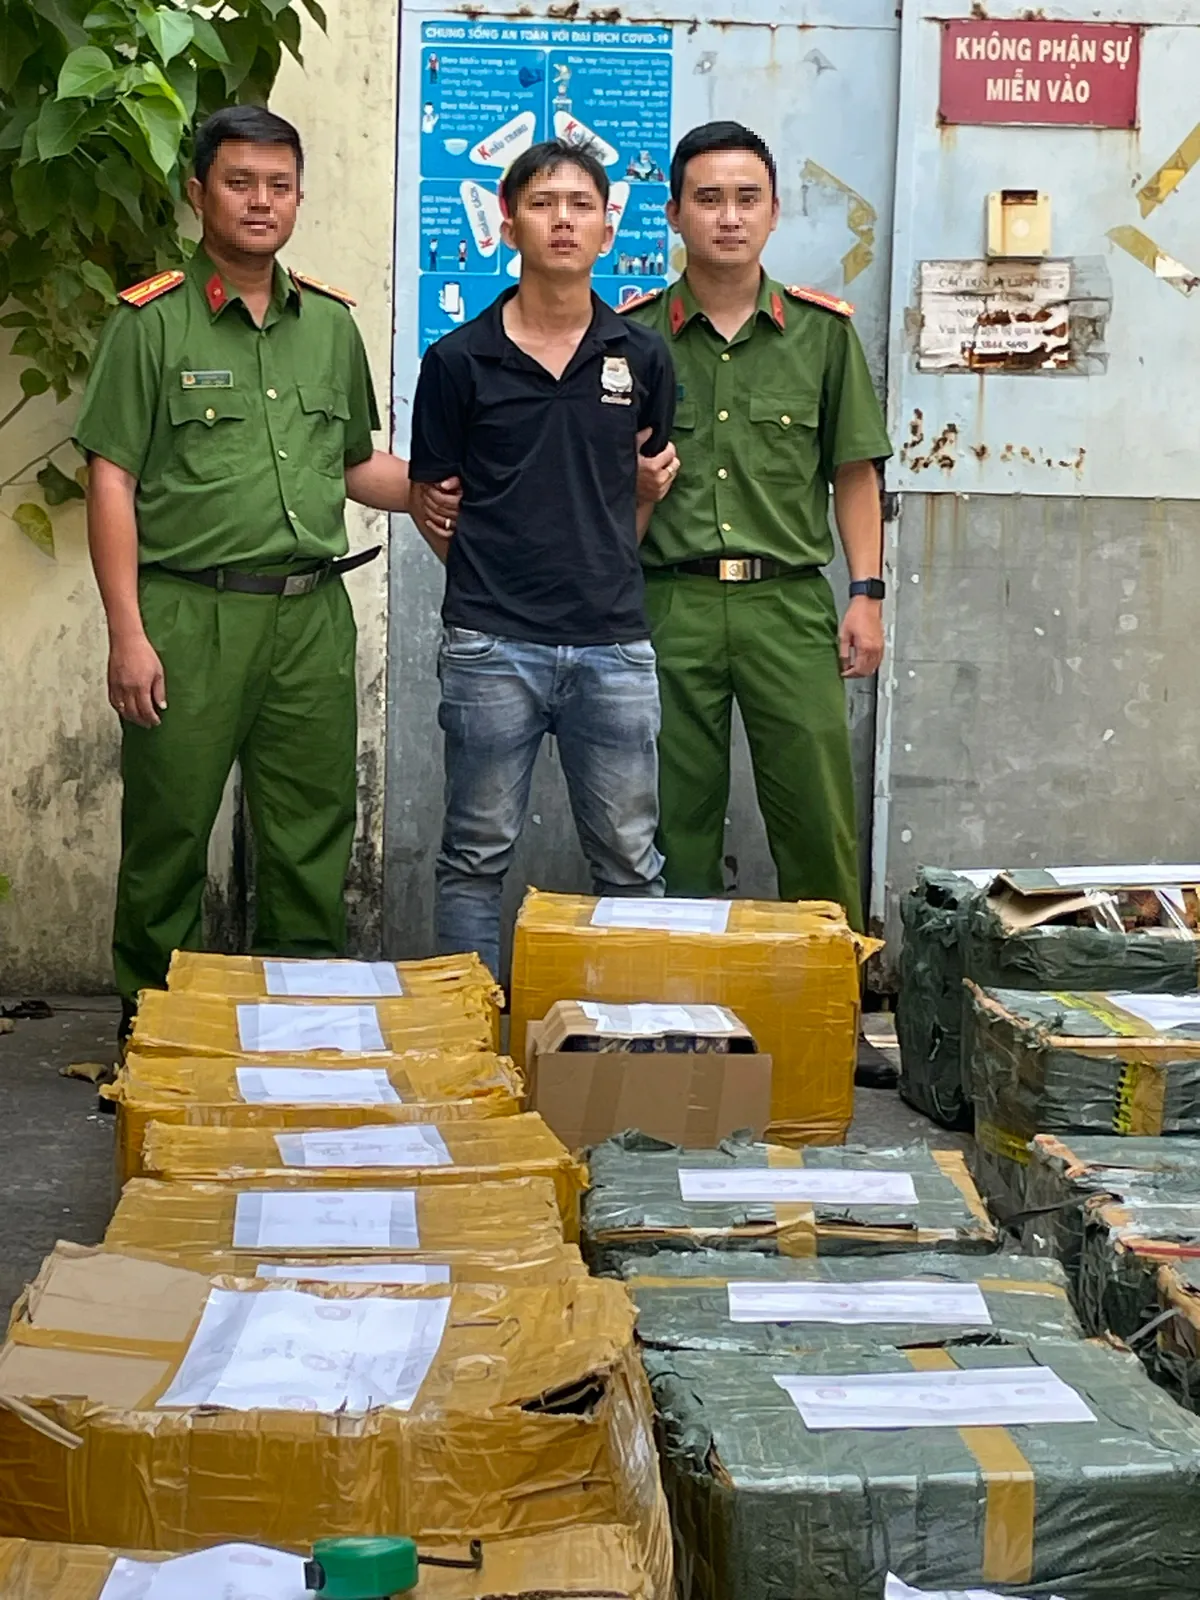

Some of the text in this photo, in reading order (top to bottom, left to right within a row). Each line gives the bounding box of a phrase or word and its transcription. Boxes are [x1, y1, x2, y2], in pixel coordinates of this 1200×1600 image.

[425, 27, 466, 39] CHUNG
[467, 24, 500, 40] SỐNG
[501, 29, 518, 40] AN
[621, 32, 669, 44] COVID-19
[955, 31, 1133, 70] KHÔNG PHẬN SỰ
[986, 68, 1090, 103] MIỄN VÀO
